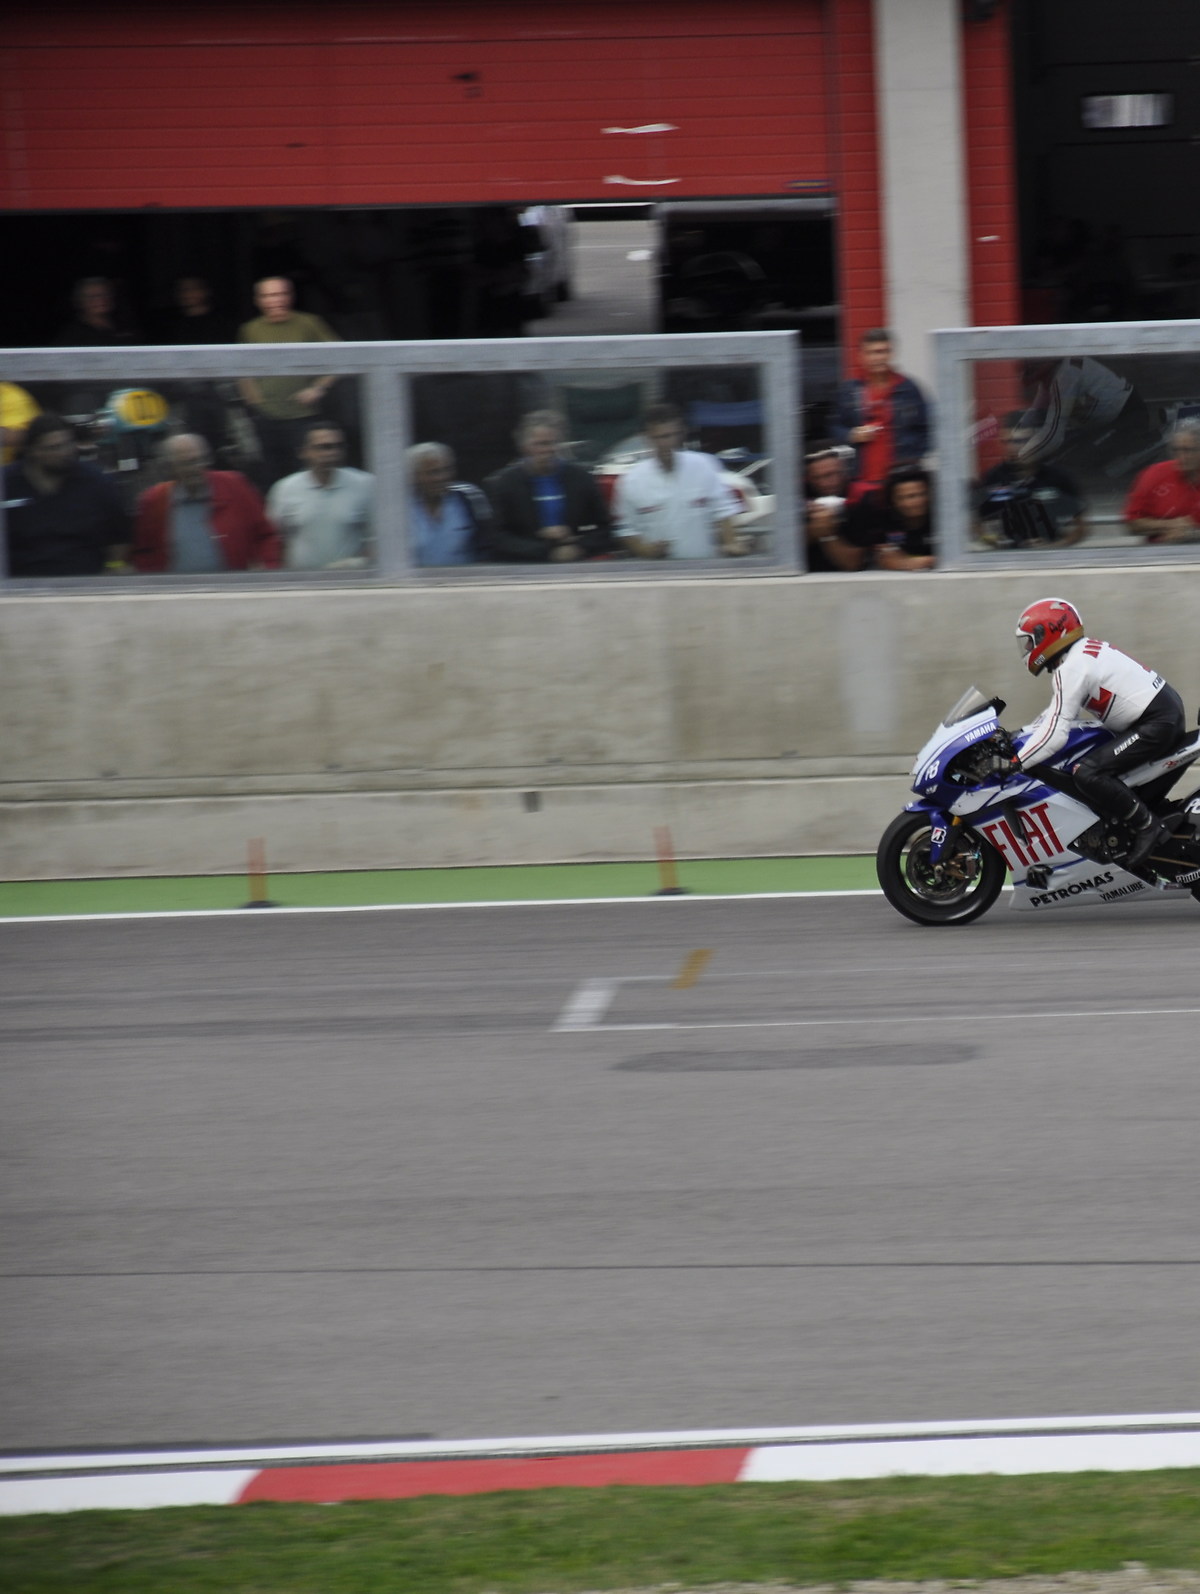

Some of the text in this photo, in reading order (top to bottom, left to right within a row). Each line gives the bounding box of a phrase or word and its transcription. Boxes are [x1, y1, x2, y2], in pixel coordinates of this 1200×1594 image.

[964, 722, 997, 743] YAMAHA
[981, 802, 1065, 872] FIAT
[1030, 871, 1115, 907] PETRONAS
[1100, 881, 1146, 902] YAMALUBE
